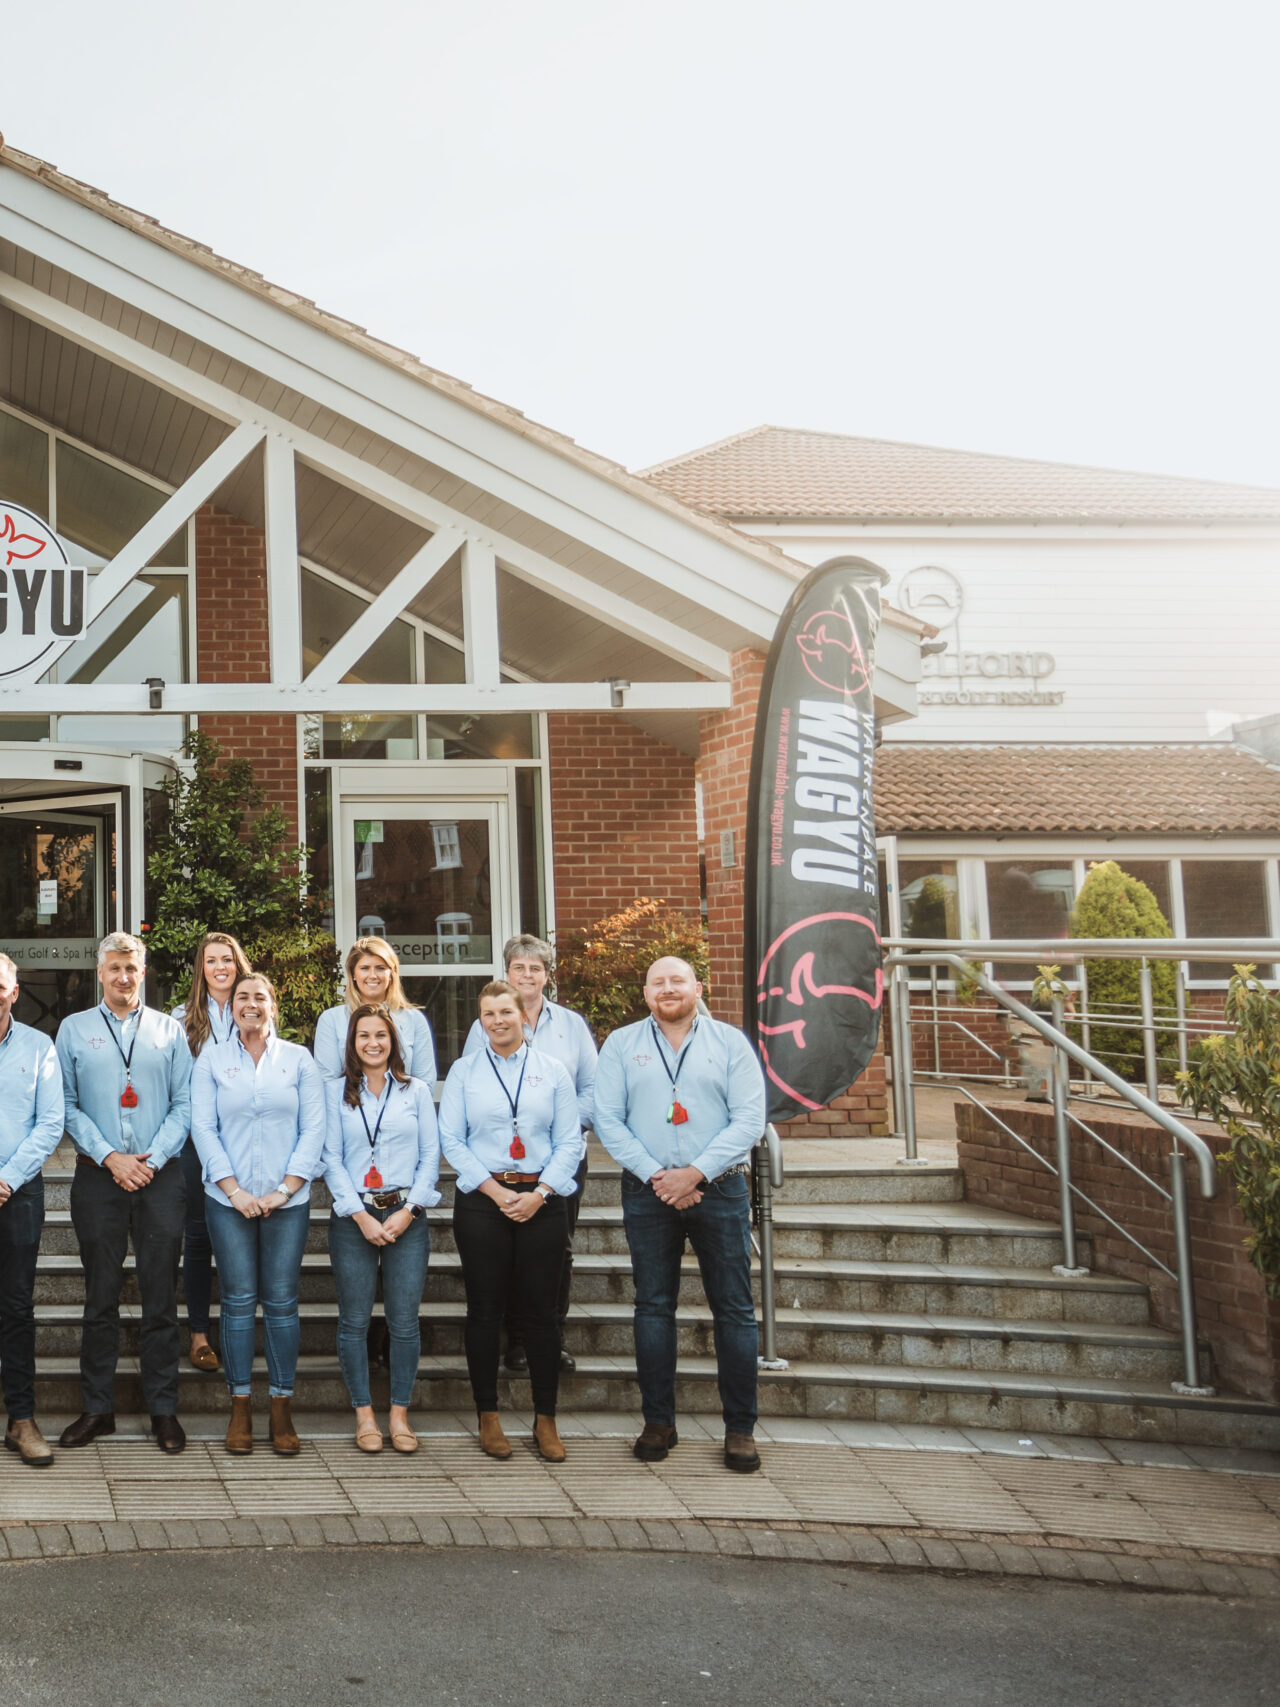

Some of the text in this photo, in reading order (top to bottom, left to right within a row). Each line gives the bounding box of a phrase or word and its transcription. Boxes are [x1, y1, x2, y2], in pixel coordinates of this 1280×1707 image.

[771, 707, 791, 866] www.warrendale-wagyu.co.uk
[790, 699, 862, 890] WAGYU
[27, 946, 48, 959] Golf
[63, 946, 80, 962] Spa
[391, 943, 469, 960] eception
